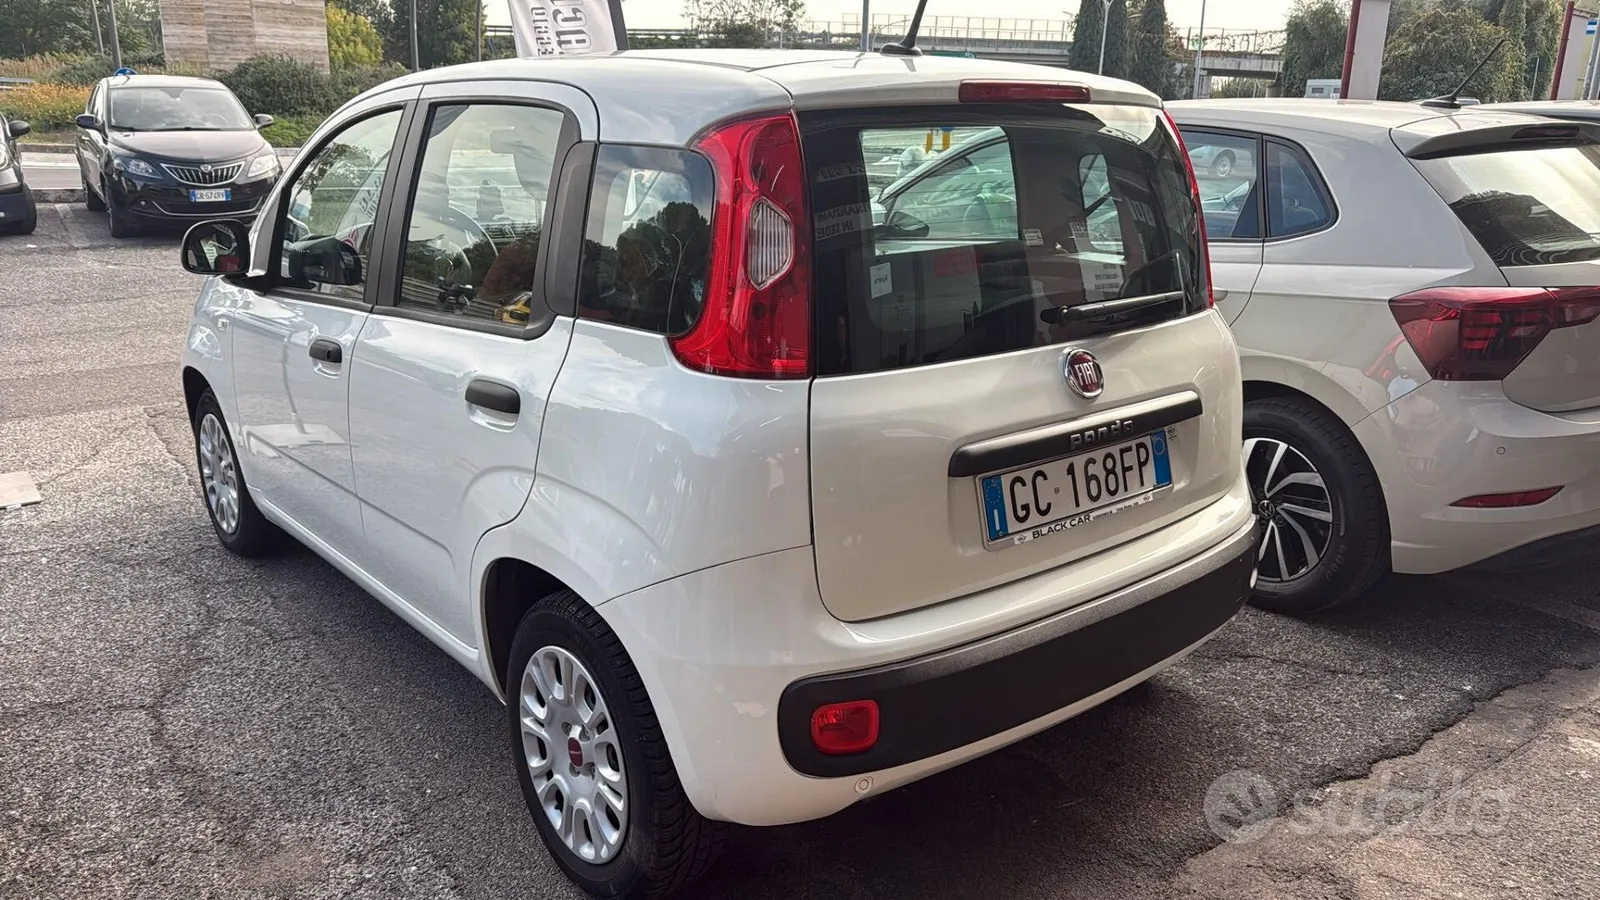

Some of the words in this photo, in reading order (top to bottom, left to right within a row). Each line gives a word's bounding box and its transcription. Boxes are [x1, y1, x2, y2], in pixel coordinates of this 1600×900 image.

[1074, 361, 1099, 386] FIAT
[1069, 419, 1134, 449] panda
[1008, 469, 1052, 524] GC
[1066, 441, 1150, 508] 168FP
[1032, 521, 1068, 539] BLACK
[1069, 514, 1092, 527] CAR
